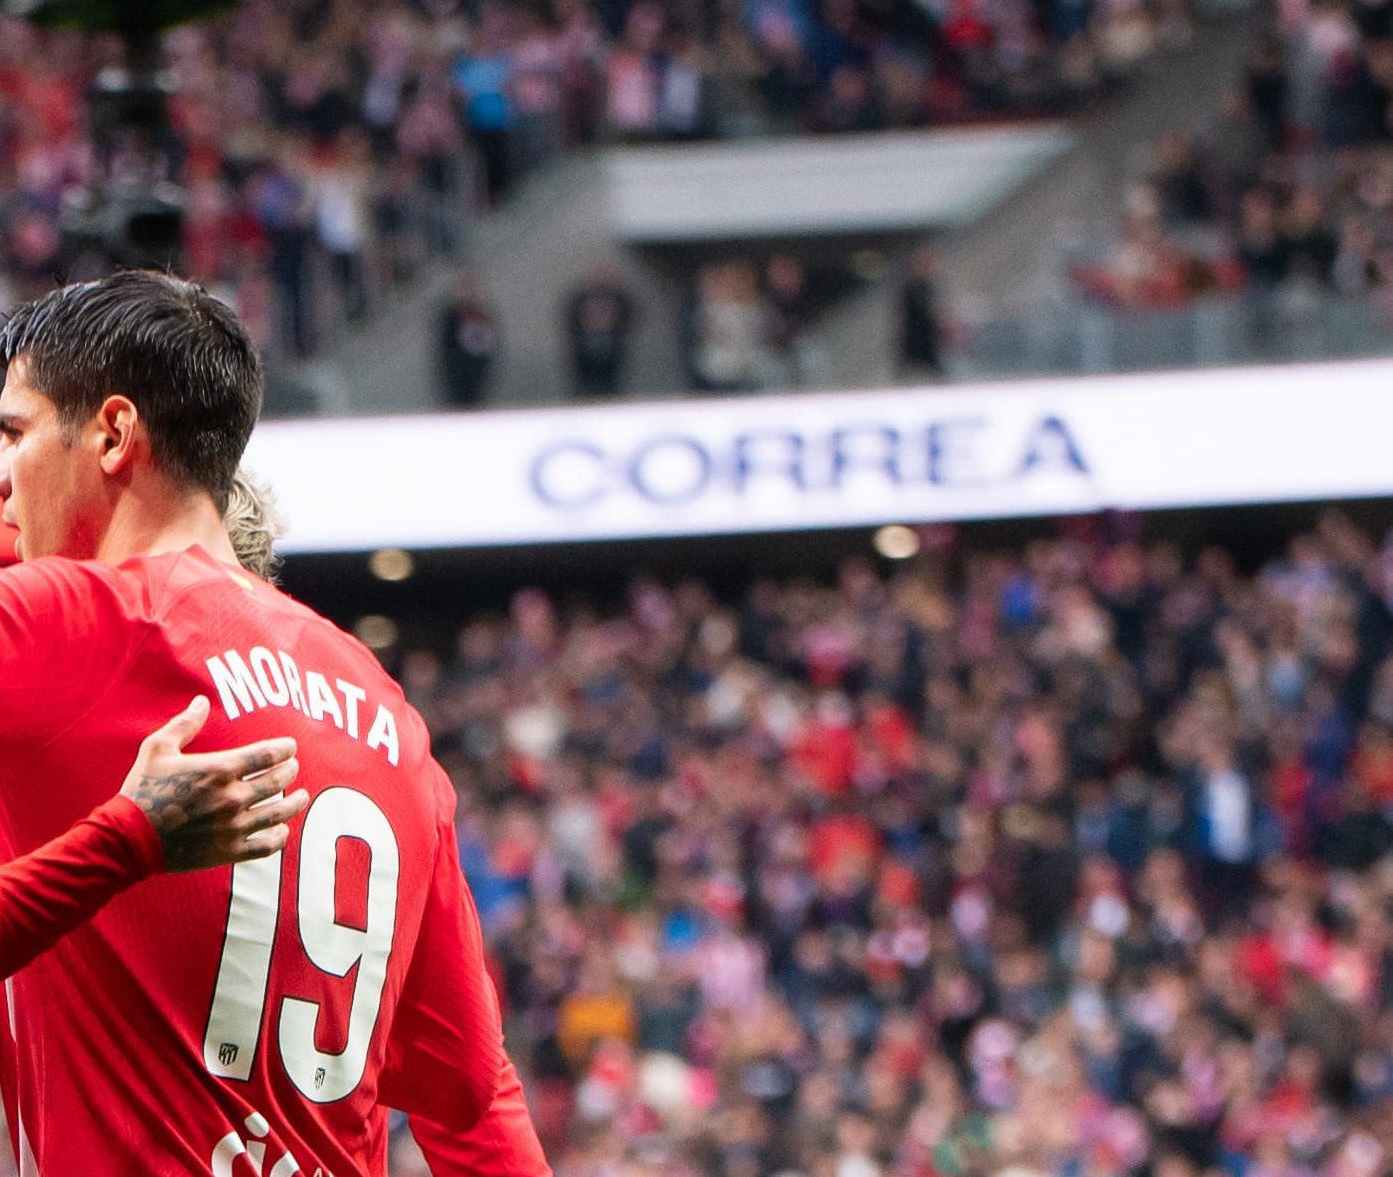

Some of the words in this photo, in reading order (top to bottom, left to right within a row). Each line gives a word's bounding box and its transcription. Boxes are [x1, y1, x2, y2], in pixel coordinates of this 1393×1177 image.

[528, 413, 1092, 510] CORREA
[206, 646, 399, 767] MORATA
[202, 786, 400, 1105] 19
